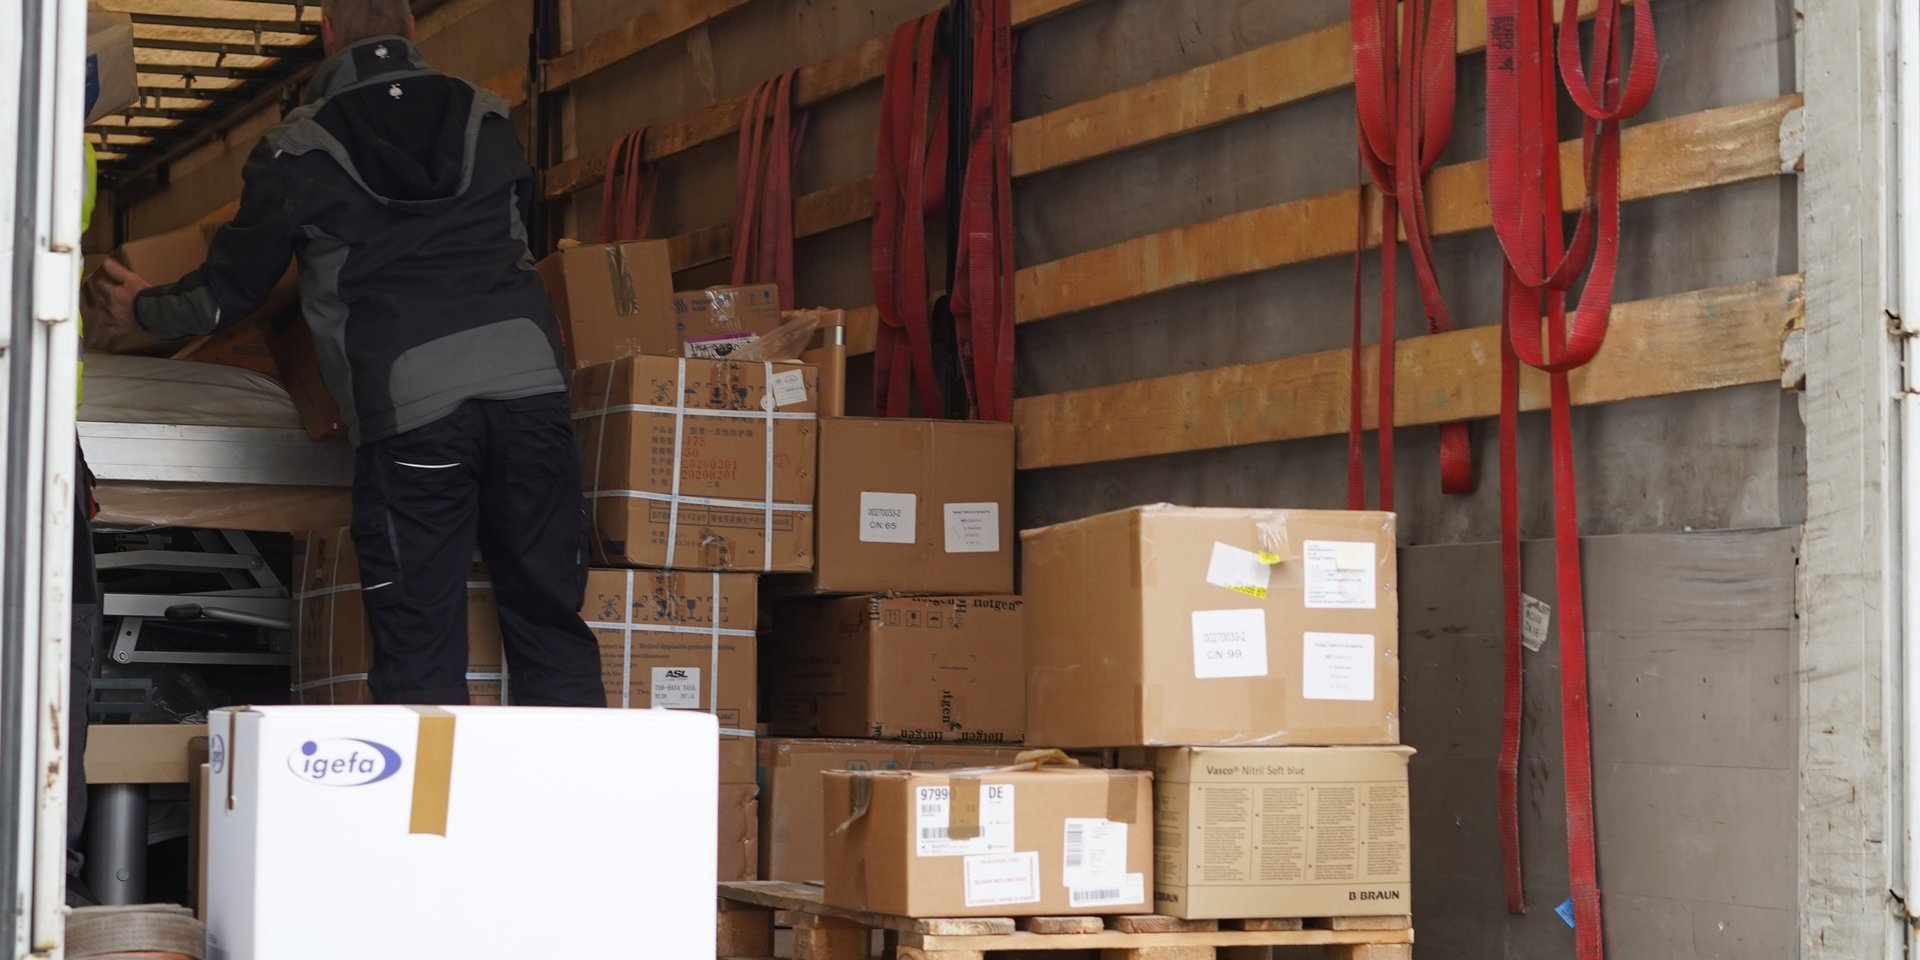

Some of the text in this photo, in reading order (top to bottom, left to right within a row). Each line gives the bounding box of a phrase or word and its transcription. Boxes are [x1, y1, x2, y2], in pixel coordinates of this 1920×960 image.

[1227, 649, 1242, 659] 99
[665, 670, 689, 678] ASL
[302, 741, 375, 779] igefa
[1241, 765, 1264, 776] Nitril
[1266, 765, 1284, 775] Soft
[1287, 765, 1305, 775] blue
[989, 786, 1004, 799] DE
[1348, 889, 1400, 901] B BRAUN
